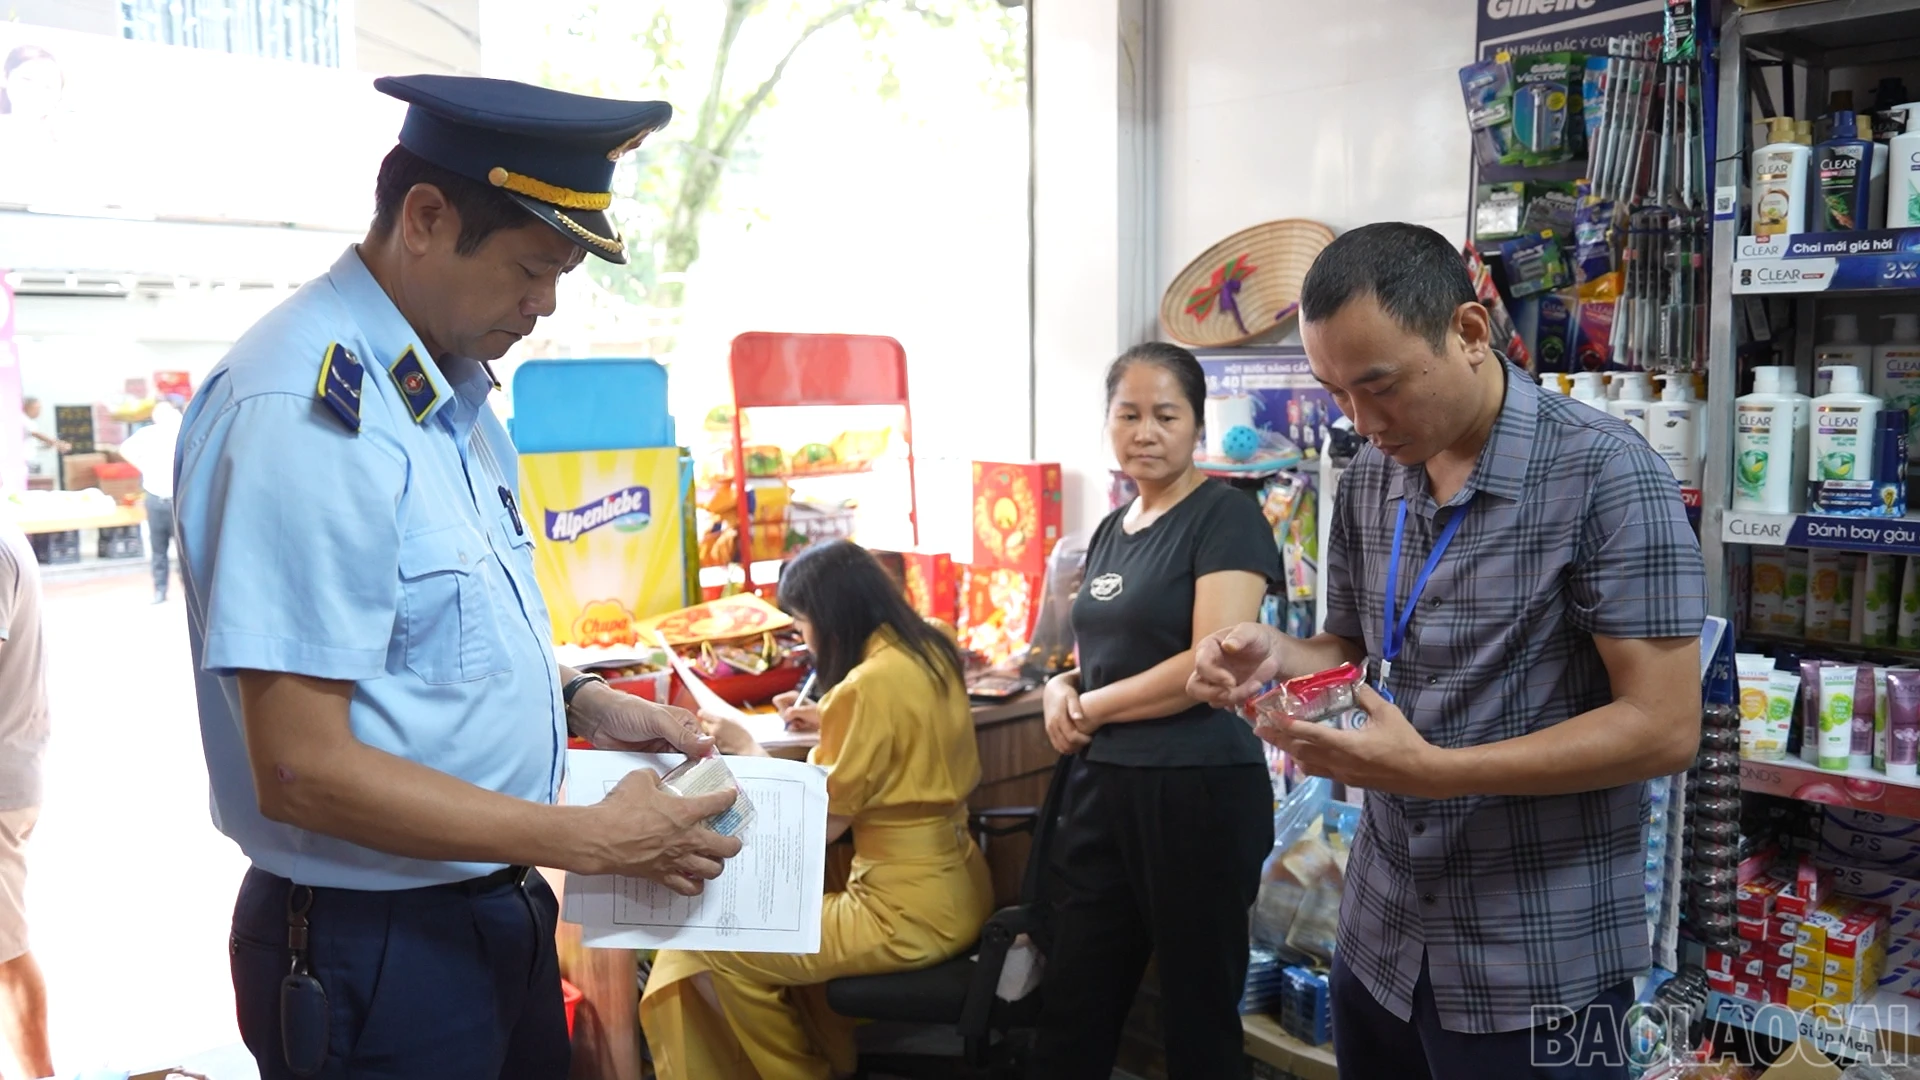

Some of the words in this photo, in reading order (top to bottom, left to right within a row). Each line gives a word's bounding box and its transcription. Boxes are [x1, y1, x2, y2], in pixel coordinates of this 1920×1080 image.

[1756, 164, 1788, 176] CLEAR
[1820, 159, 1857, 171] CLEAR
[1742, 244, 1779, 257] CLEAR
[1792, 243, 1821, 253] Chai
[1824, 241, 1847, 252] mới
[1849, 240, 1871, 253] giá
[1873, 238, 1893, 249] hời
[1757, 267, 1801, 282] CLEAR
[1738, 413, 1772, 426] CLEAR
[1818, 415, 1859, 427] CLEAR
[552, 489, 642, 541] Alpenliebe
[1729, 519, 1781, 538] CLEAR
[1807, 522, 1847, 538] Đánh
[1850, 525, 1880, 543] bay
[1883, 526, 1915, 544] gàu
[1849, 834, 1882, 852] P/S
[1832, 867, 1863, 885] P/S
[1716, 998, 1755, 1022] P/S
[1799, 1022, 1835, 1044] Giúp
[1838, 1034, 1874, 1053] Men
